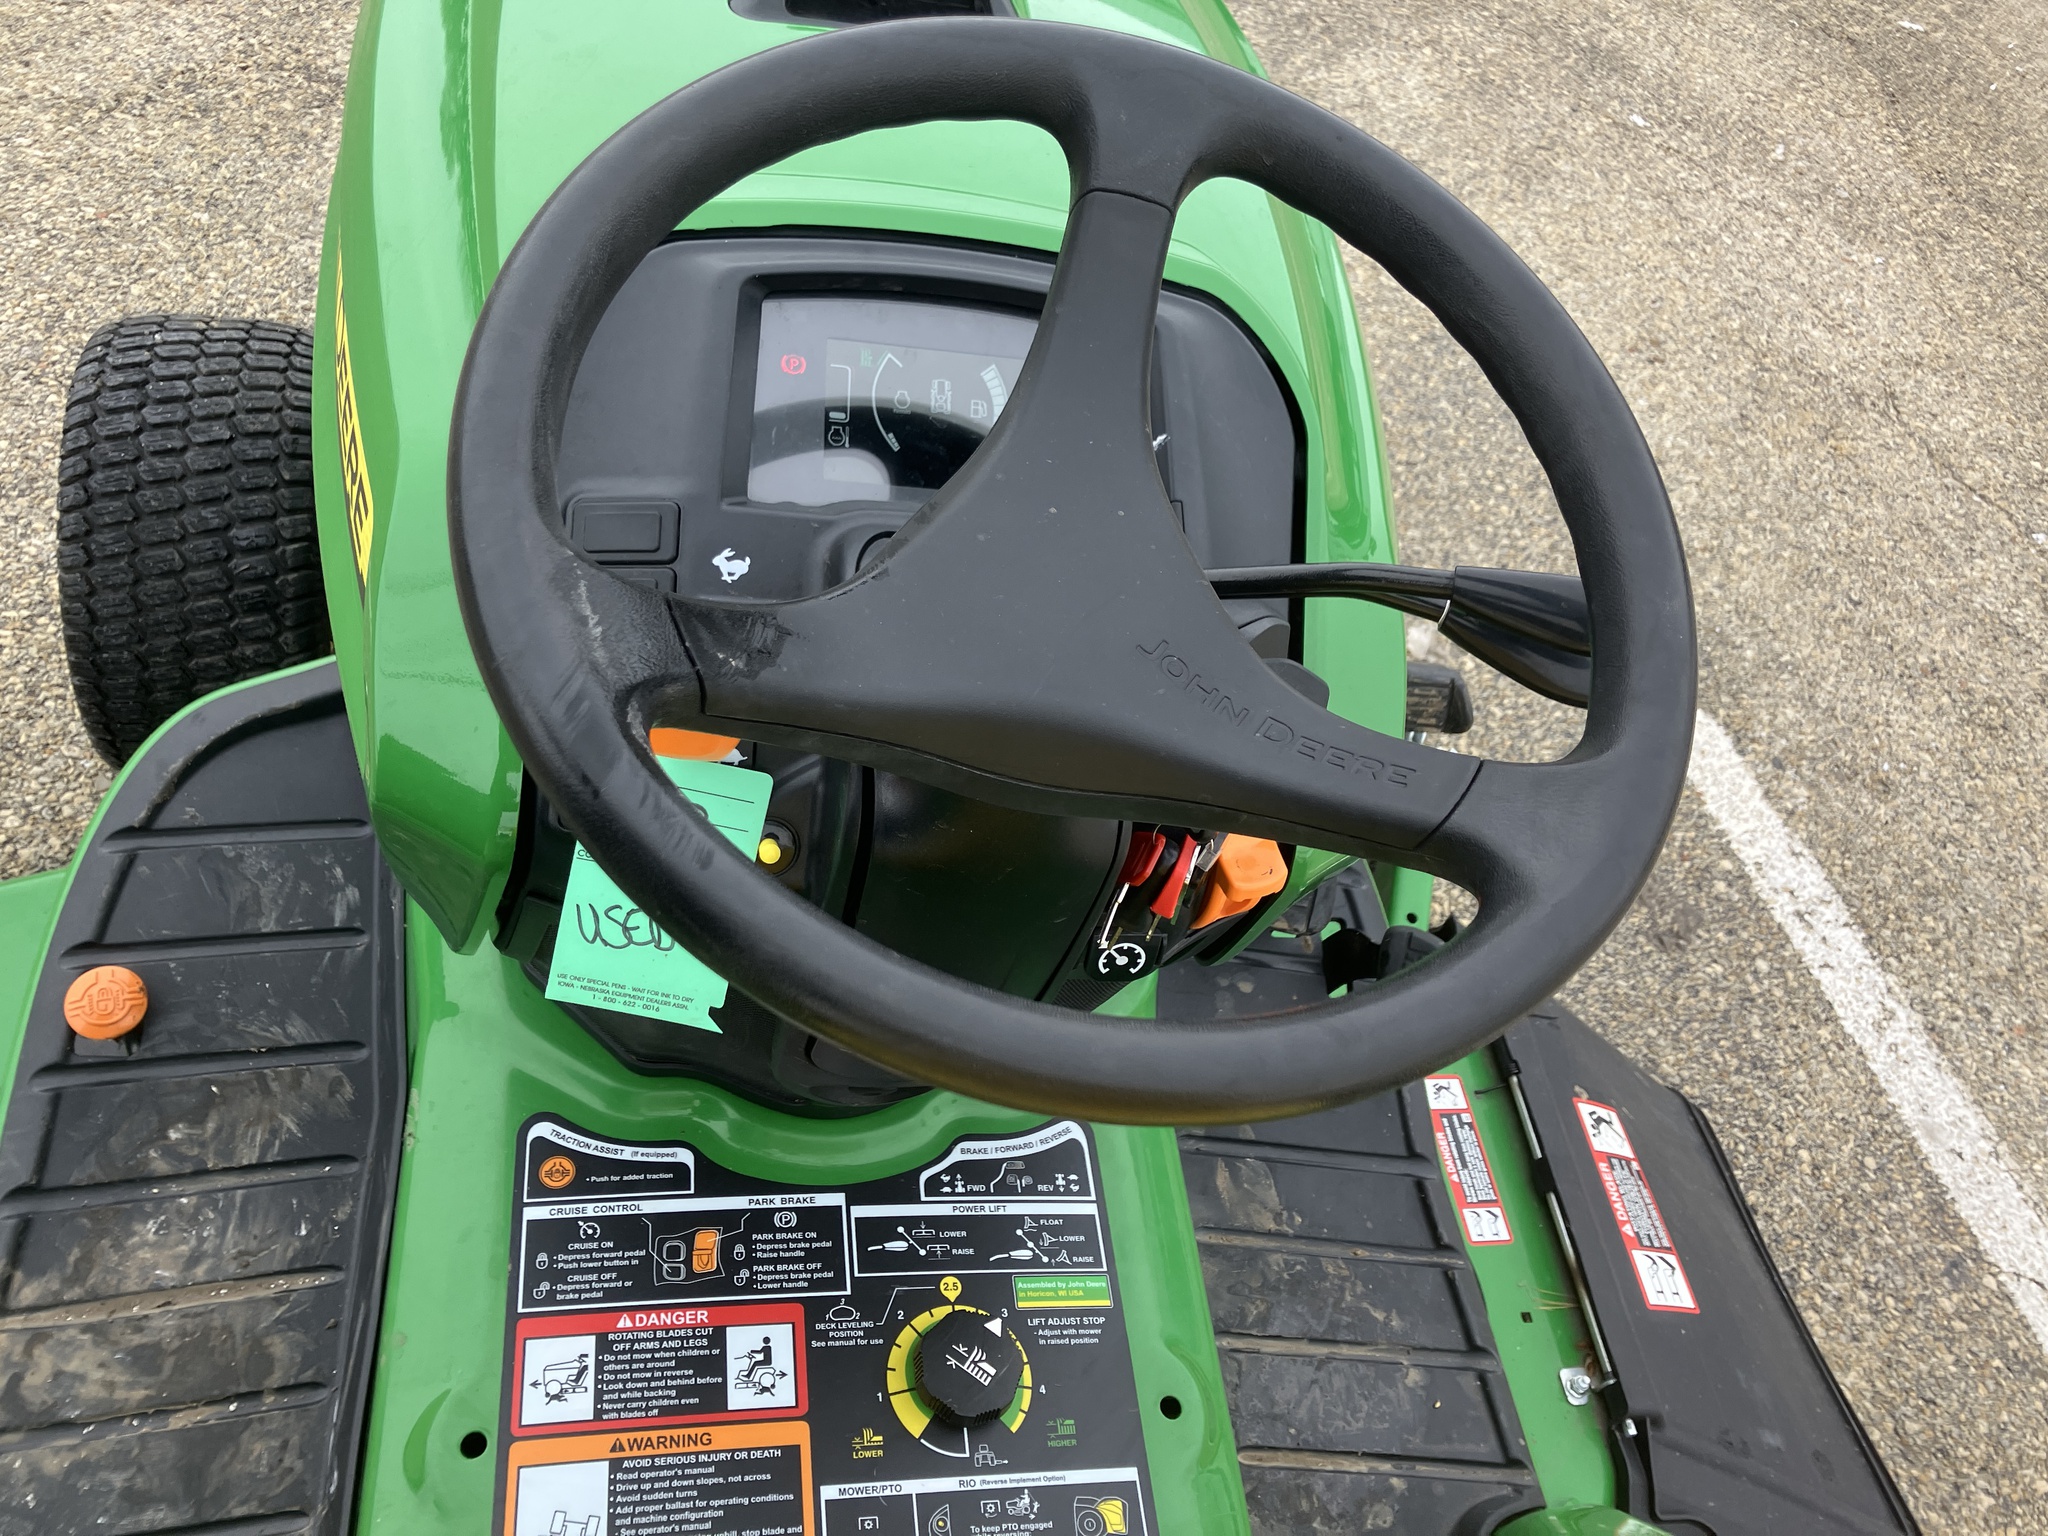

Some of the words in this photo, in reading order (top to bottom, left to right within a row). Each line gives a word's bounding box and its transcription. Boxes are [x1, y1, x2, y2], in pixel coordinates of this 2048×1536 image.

[1136, 639, 1249, 727] JOHN
[1254, 716, 1416, 787] DEERE
[576, 904, 676, 951] USED
[586, 977, 609, 987] SPECIAL
[579, 984, 610, 995] NEBRASKA
[611, 990, 645, 1001] EQUIPMENT
[645, 996, 671, 1006] DEALERS
[671, 1002, 688, 1010] ASSN.
[550, 1129, 592, 1150] TRACTION
[592, 1144, 625, 1156] ASSIST
[995, 1143, 1034, 1153] FORWARD
[1038, 1127, 1072, 1146] REVERSE
[1436, 1132, 1456, 1172] DANGER
[1598, 1162, 1628, 1221] DANGER
[748, 1197, 775, 1206] PARK
[780, 1196, 815, 1204] BRAKE
[549, 1206, 587, 1216] CRUISE
[592, 1203, 643, 1213] CONTROL
[567, 1241, 599, 1250] CRUISE
[811, 1240, 832, 1248] pedal
[592, 1250, 622, 1258] forward
[624, 1249, 645, 1258] pedal
[567, 1273, 598, 1282] CRUISE
[757, 1273, 788, 1281] Depress
[813, 1270, 833, 1279] pedal
[943, 1282, 959, 1291] 2.5
[635, 1310, 708, 1326] DANGER
[897, 1310, 904, 1319] 2
[1001, 1309, 1008, 1317] 3
[1027, 1318, 1045, 1326] LIFT
[1047, 1317, 1080, 1325] ADJUST
[608, 1330, 654, 1340] ROTATING
[656, 1328, 693, 1338] BLADES
[695, 1327, 713, 1335] CUT
[1038, 1328, 1061, 1336] Adjust
[612, 1342, 631, 1351] OFF
[632, 1341, 660, 1350] ARMS
[661, 1339, 681, 1348] AND
[683, 1338, 708, 1346] LEGS
[827, 1338, 855, 1346] manual
[677, 1348, 709, 1356] children
[646, 1359, 675, 1368] around
[602, 1382, 623, 1390] Look
[649, 1379, 665, 1387] and
[667, 1377, 695, 1386] behind
[696, 1376, 722, 1384] before
[602, 1392, 618, 1400] and
[643, 1388, 676, 1397] backing
[1039, 1385, 1046, 1394] 4
[626, 1432, 712, 1451] WARNING
[1047, 1439, 1077, 1447] HIGHER
[622, 1458, 652, 1468] AVOID
[654, 1454, 696, 1466] SERIOUS
[698, 1452, 732, 1462] INJURY
[734, 1451, 748, 1460] OR
[750, 1449, 781, 1458] DEATH
[852, 1449, 883, 1458] LOWER
[616, 1471, 638, 1480] Read
[639, 1468, 682, 1479] operator's
[684, 1465, 714, 1474] manual
[616, 1483, 638, 1491] Drive
[640, 1482, 651, 1490] up
[653, 1479, 669, 1488] and
[696, 1477, 726, 1485] slopes,
[838, 1483, 902, 1496] MOWER/PTO
[959, 1479, 976, 1488] RIO
[615, 1493, 640, 1503] Avoid
[642, 1491, 673, 1500] sudden
[981, 1525, 1000, 1533] keep
[1001, 1522, 1018, 1531] PTO
[1020, 1520, 1052, 1531] engaged
